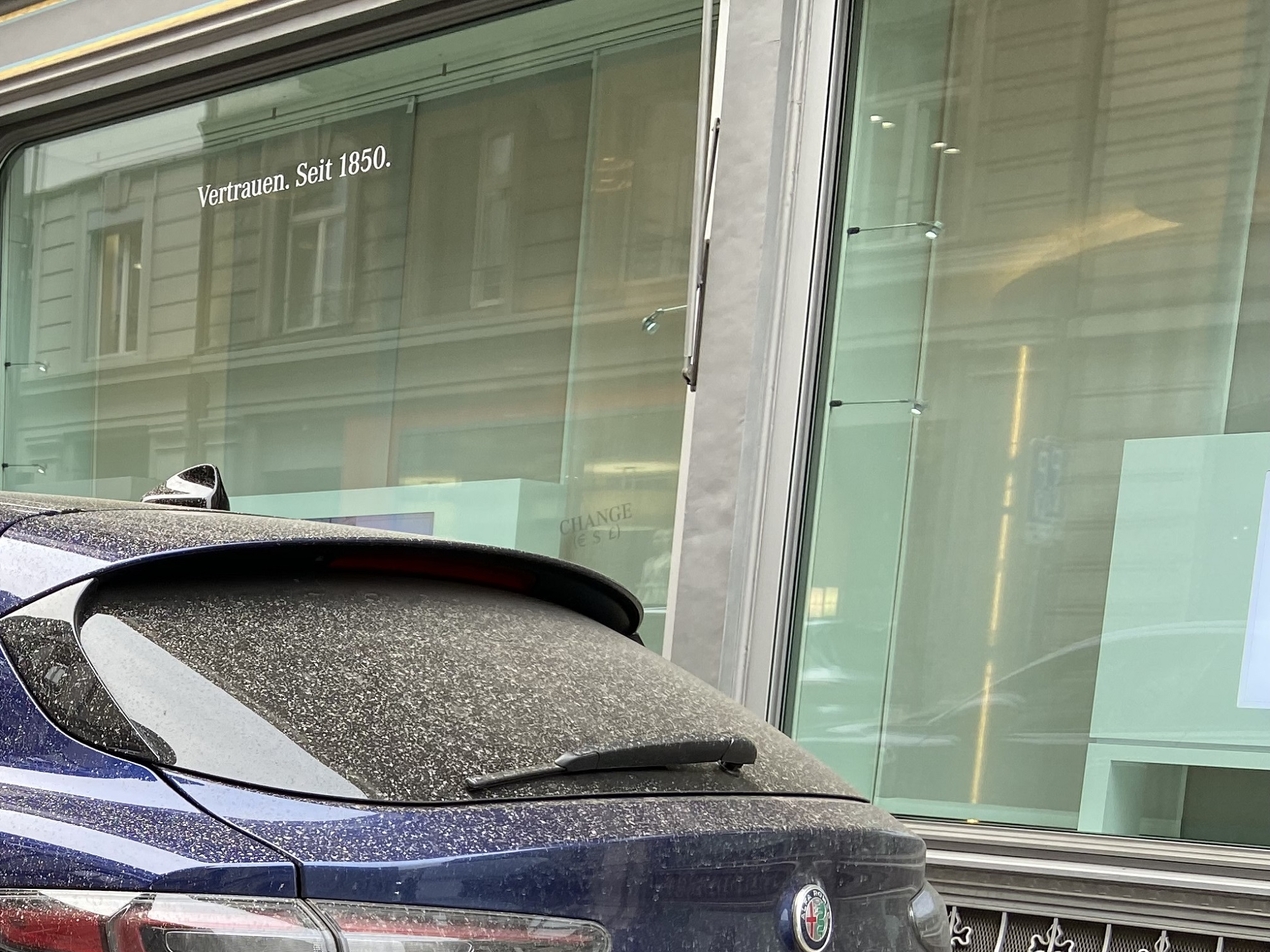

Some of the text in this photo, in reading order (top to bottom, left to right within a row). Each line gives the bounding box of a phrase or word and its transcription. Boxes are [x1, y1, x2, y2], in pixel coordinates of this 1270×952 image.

[196, 145, 392, 208] Vertrauen. Seit 1850.
[559, 502, 633, 535] CHANGE
